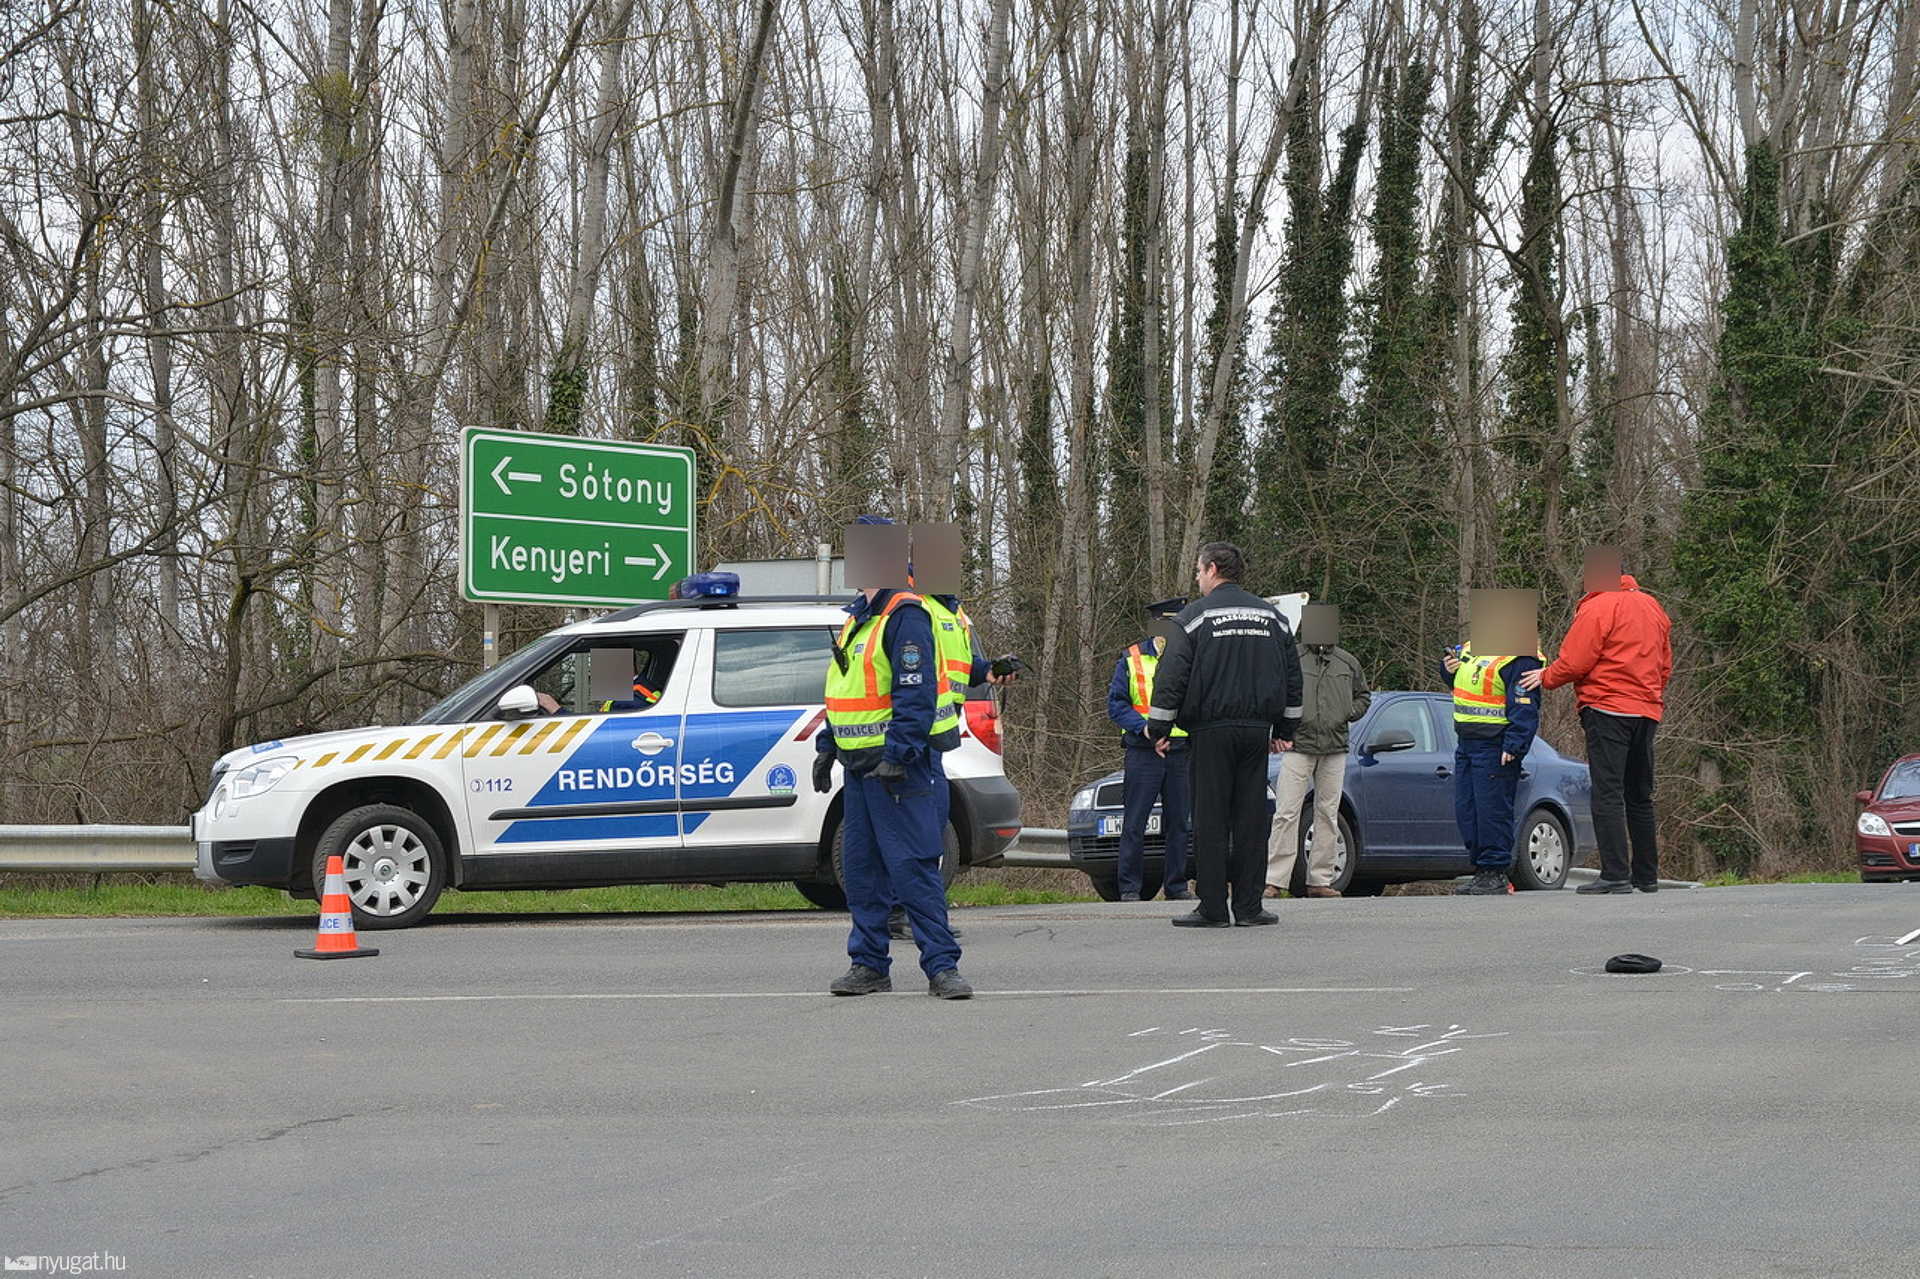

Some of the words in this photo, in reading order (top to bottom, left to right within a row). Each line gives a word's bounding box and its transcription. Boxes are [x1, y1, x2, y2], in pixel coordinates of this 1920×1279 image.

[559, 462, 672, 515] Sótony
[490, 535, 610, 583] Kenyeri
[837, 725, 875, 736] POLICE
[485, 778, 513, 792] 112
[559, 758, 735, 791] RENDŐRSÉG
